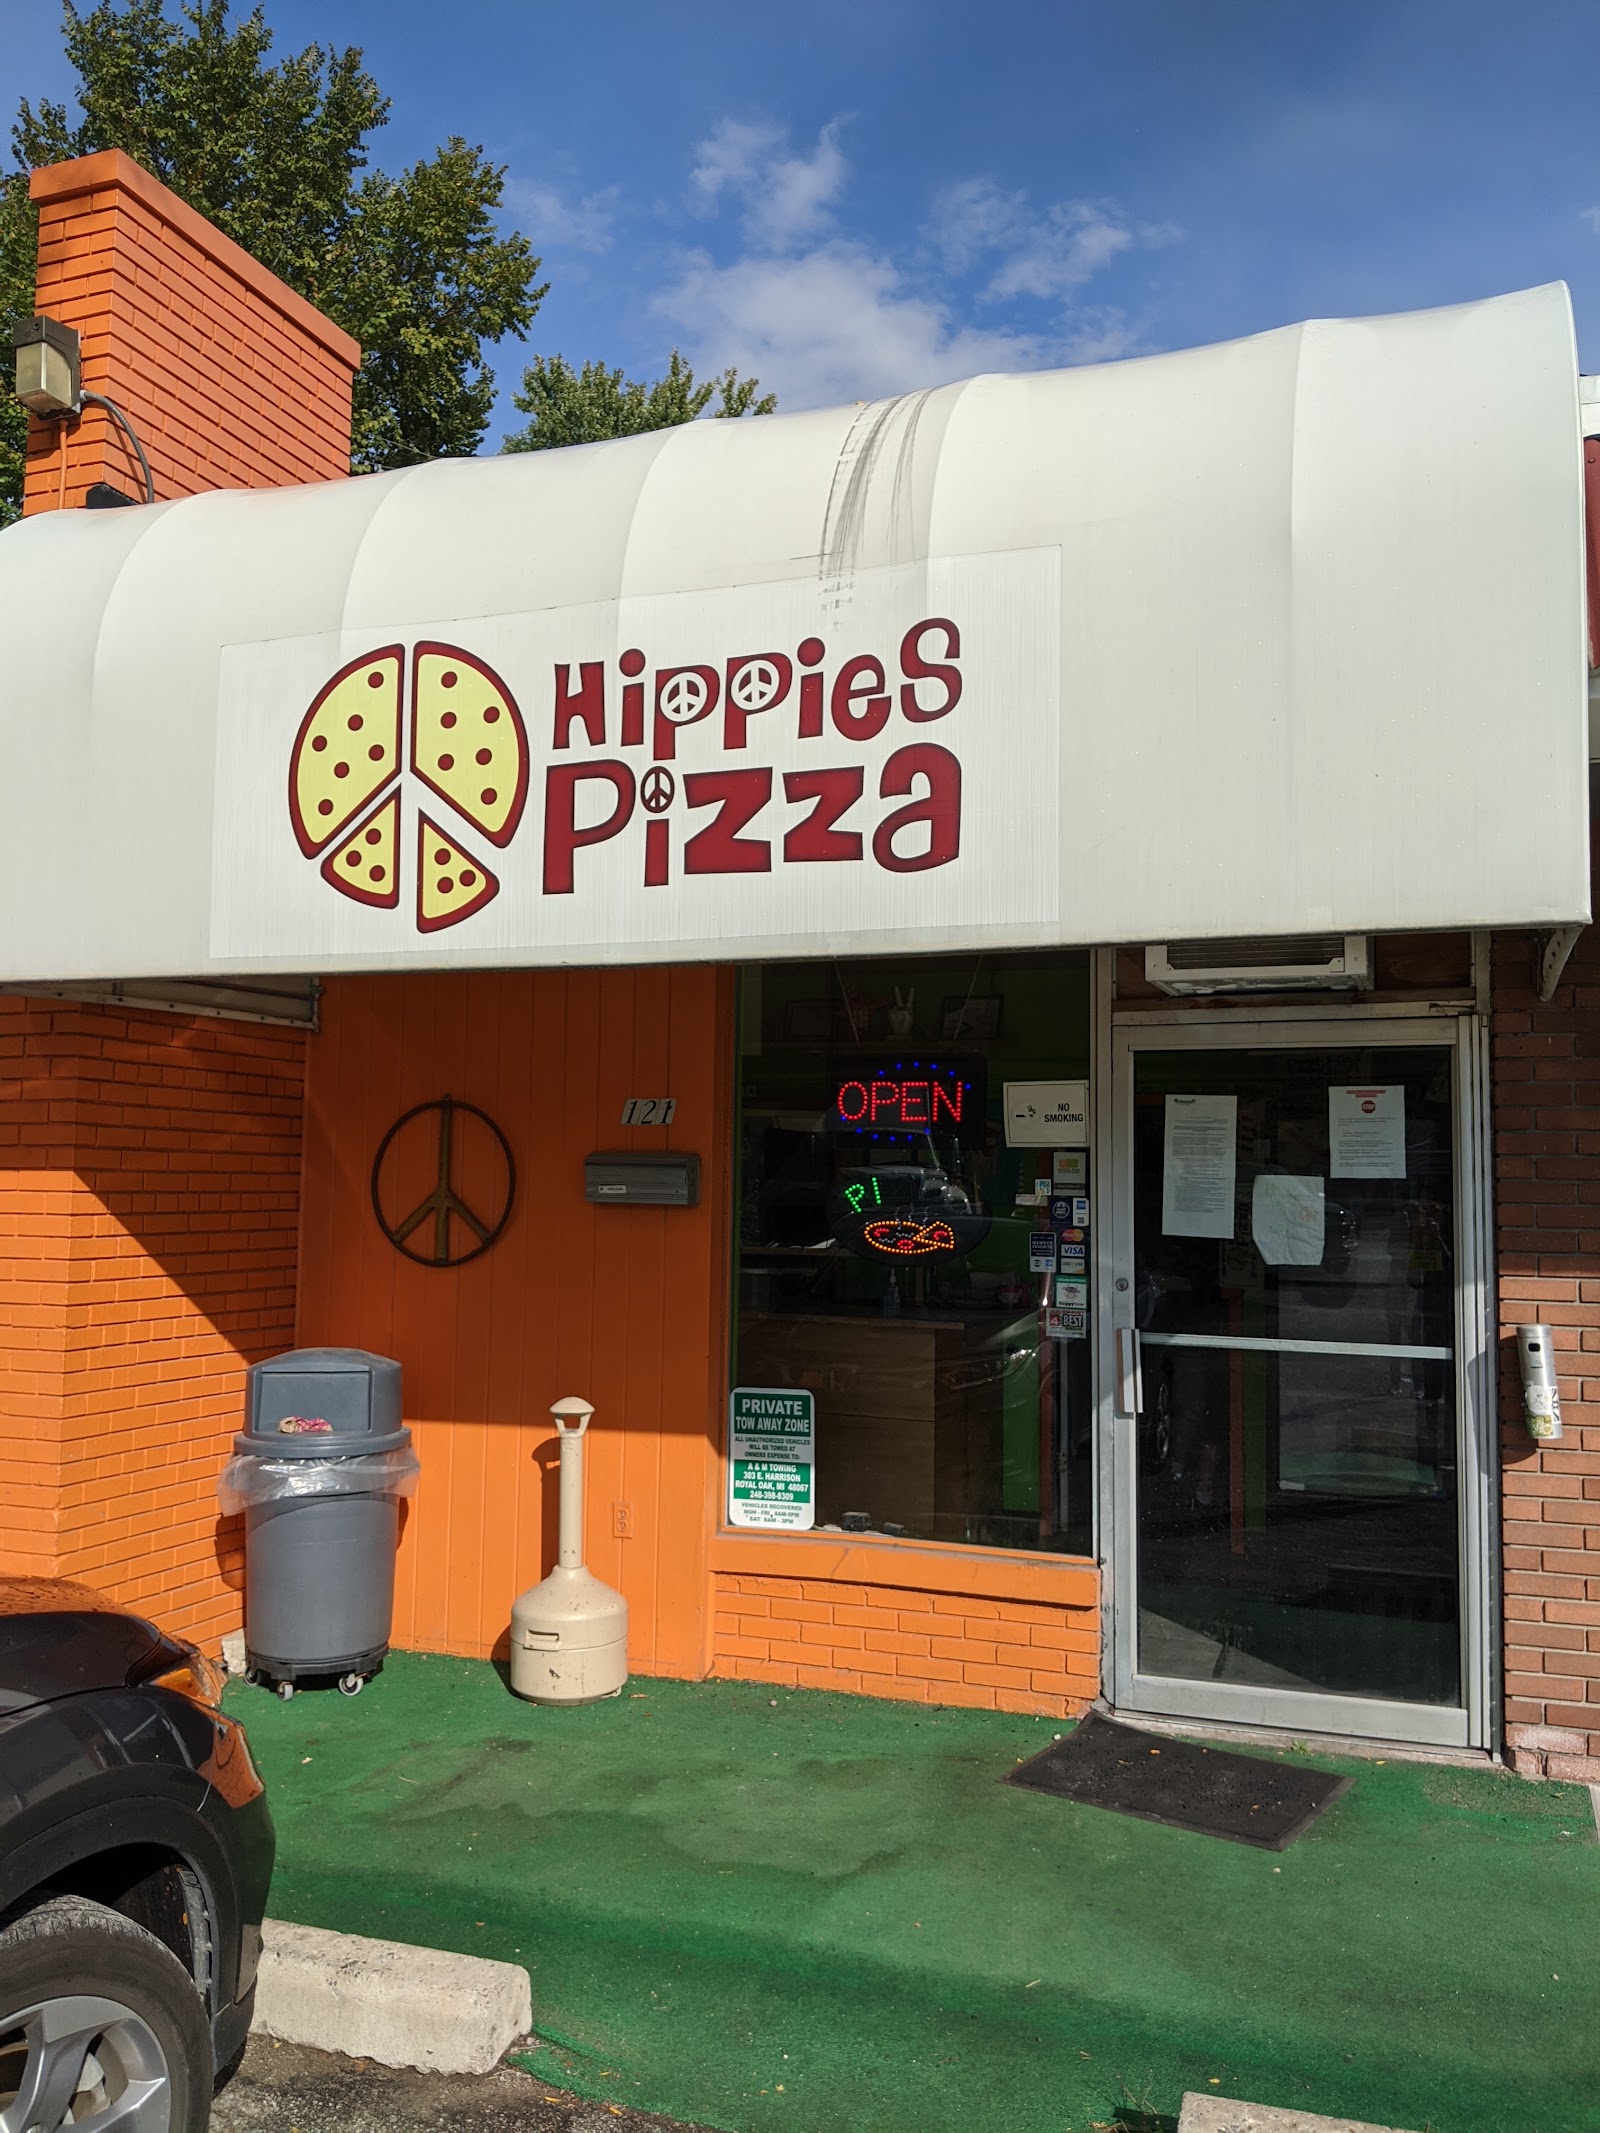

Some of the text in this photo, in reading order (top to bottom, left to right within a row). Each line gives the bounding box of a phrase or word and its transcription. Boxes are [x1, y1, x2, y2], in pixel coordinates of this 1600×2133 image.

[541, 742, 962, 897] Pizza
[837, 1081, 963, 1122] OPEN
[1057, 1103, 1070, 1112] NO
[625, 1099, 672, 1124] 121
[1044, 1113, 1084, 1123] SMOKING
[1064, 1246, 1084, 1255] VISA
[1064, 1315, 1083, 1327] BEST
[742, 1399, 802, 1415] PRIVATE
[736, 1416, 809, 1432] TOW AWAY ZONE
[769, 1464, 796, 1472] TOWING
[765, 1473, 800, 1482] HARRISON
[735, 1480, 757, 1489] ROYAL
[758, 1482, 775, 1491] OAK,
[788, 1483, 808, 1492] 48067
